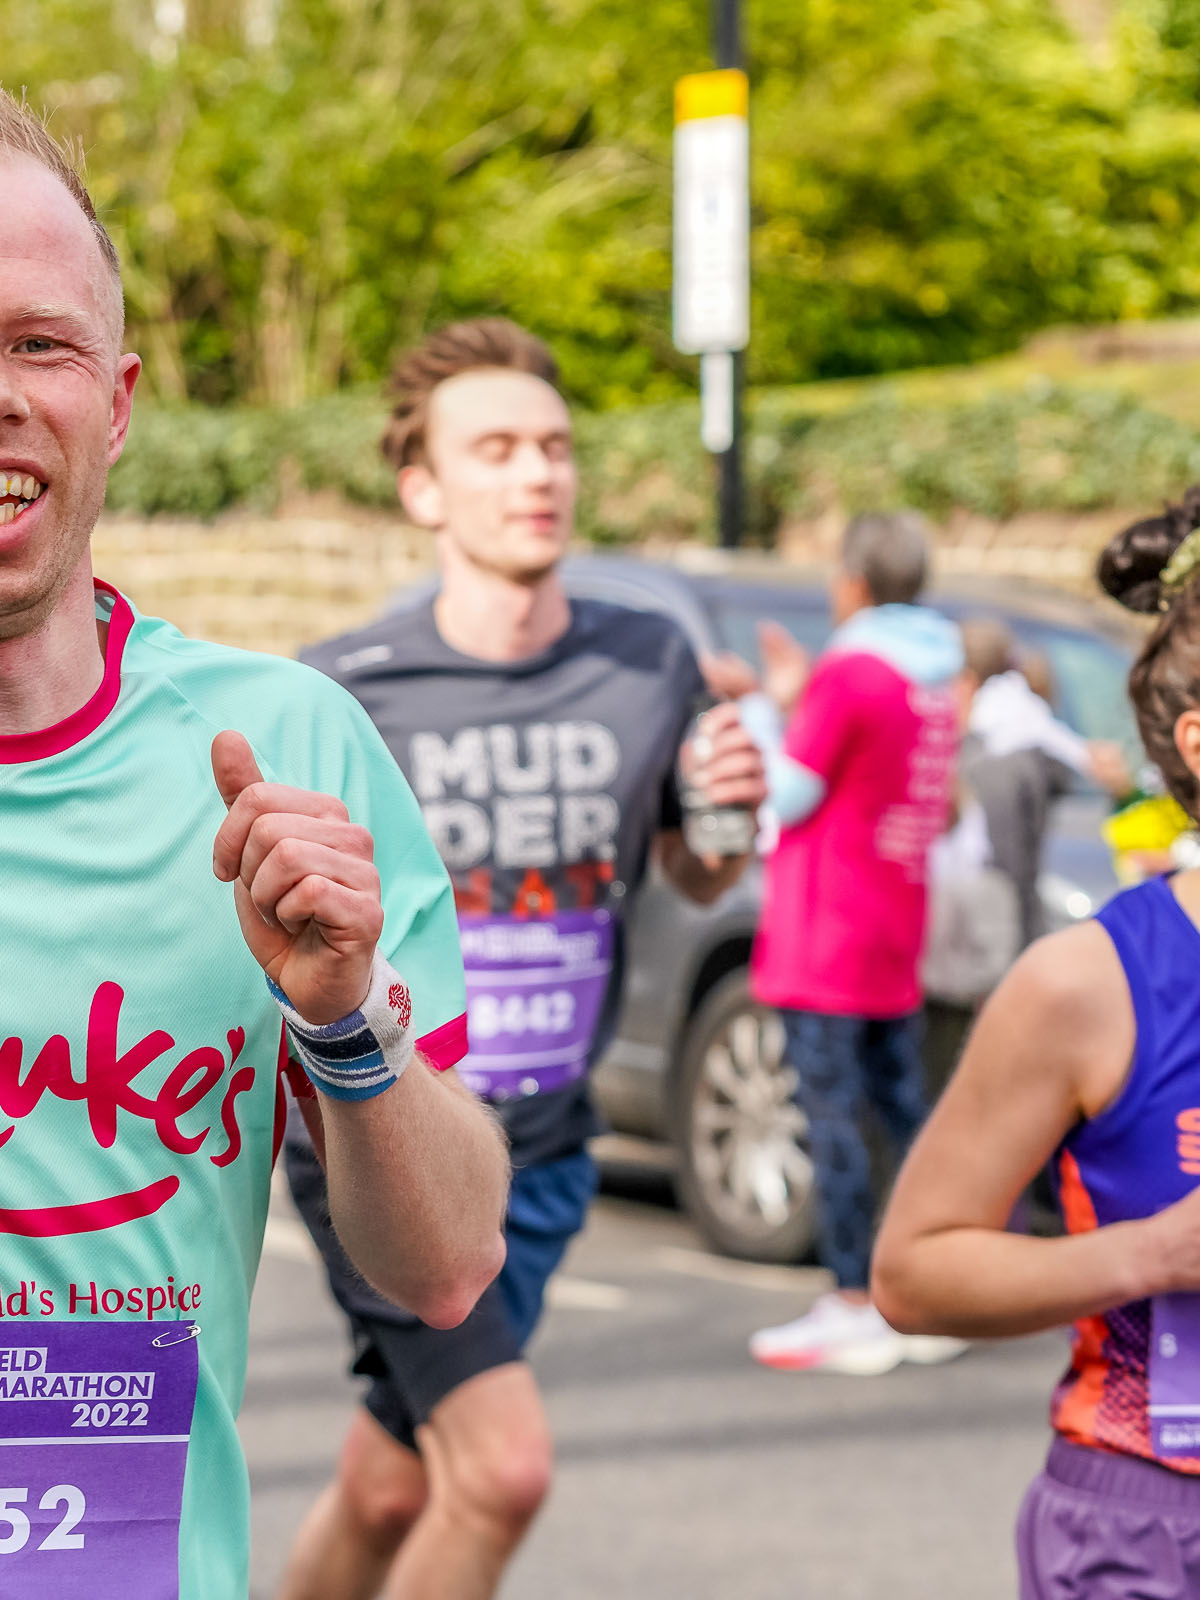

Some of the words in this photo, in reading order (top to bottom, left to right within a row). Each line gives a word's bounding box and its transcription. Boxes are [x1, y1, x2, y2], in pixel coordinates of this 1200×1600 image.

[409, 720, 621, 799] MUD
[420, 791, 620, 869] DER
[68, 1276, 201, 1321] Hospice
[70, 1402, 150, 1428] 2022
